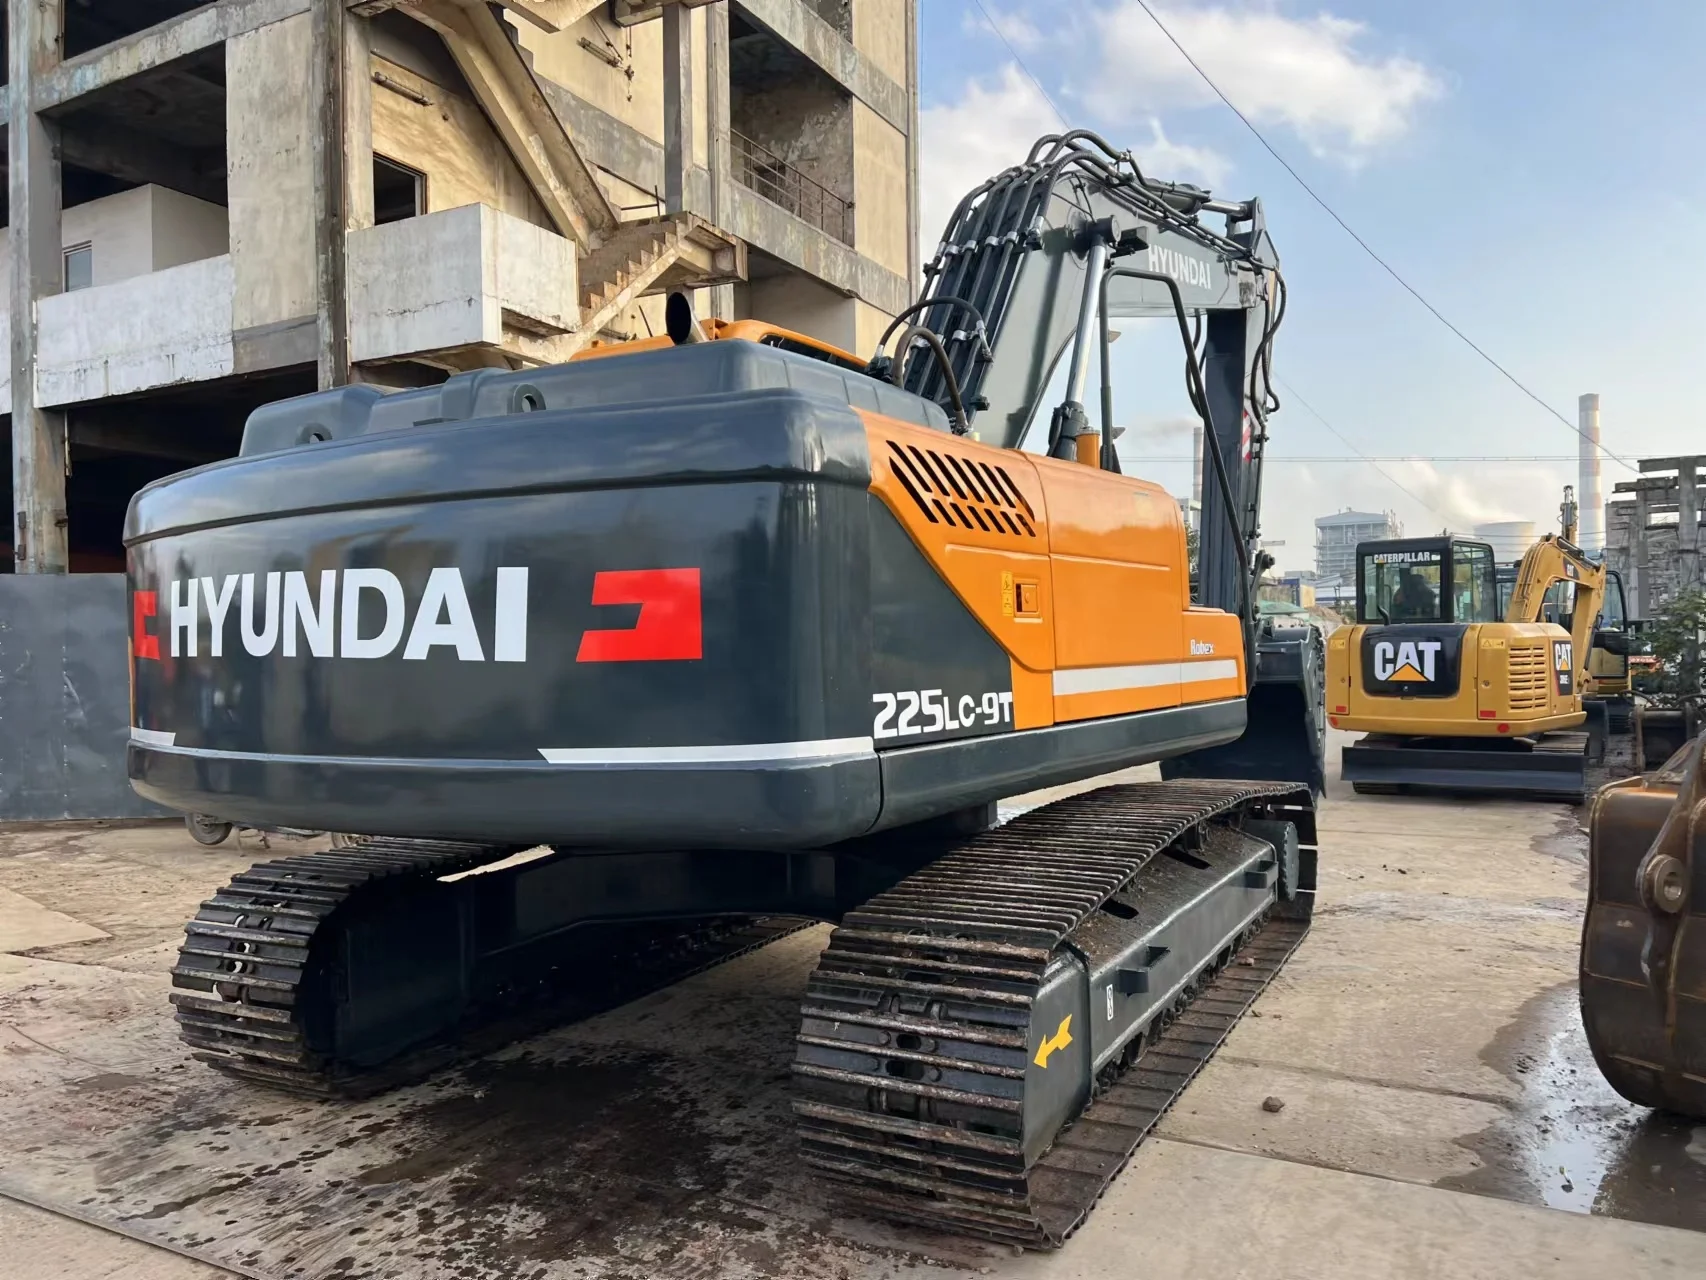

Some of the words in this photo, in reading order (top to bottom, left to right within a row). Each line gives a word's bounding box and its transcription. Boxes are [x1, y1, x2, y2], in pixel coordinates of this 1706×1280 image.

[1148, 244, 1211, 289] HYUNDAI
[1373, 552, 1430, 563] CATERPILLAR
[170, 566, 529, 662] HYUNDAI
[1374, 641, 1441, 682] CAT
[1555, 643, 1571, 671] CAT
[872, 688, 1013, 739] 225LC-9T
